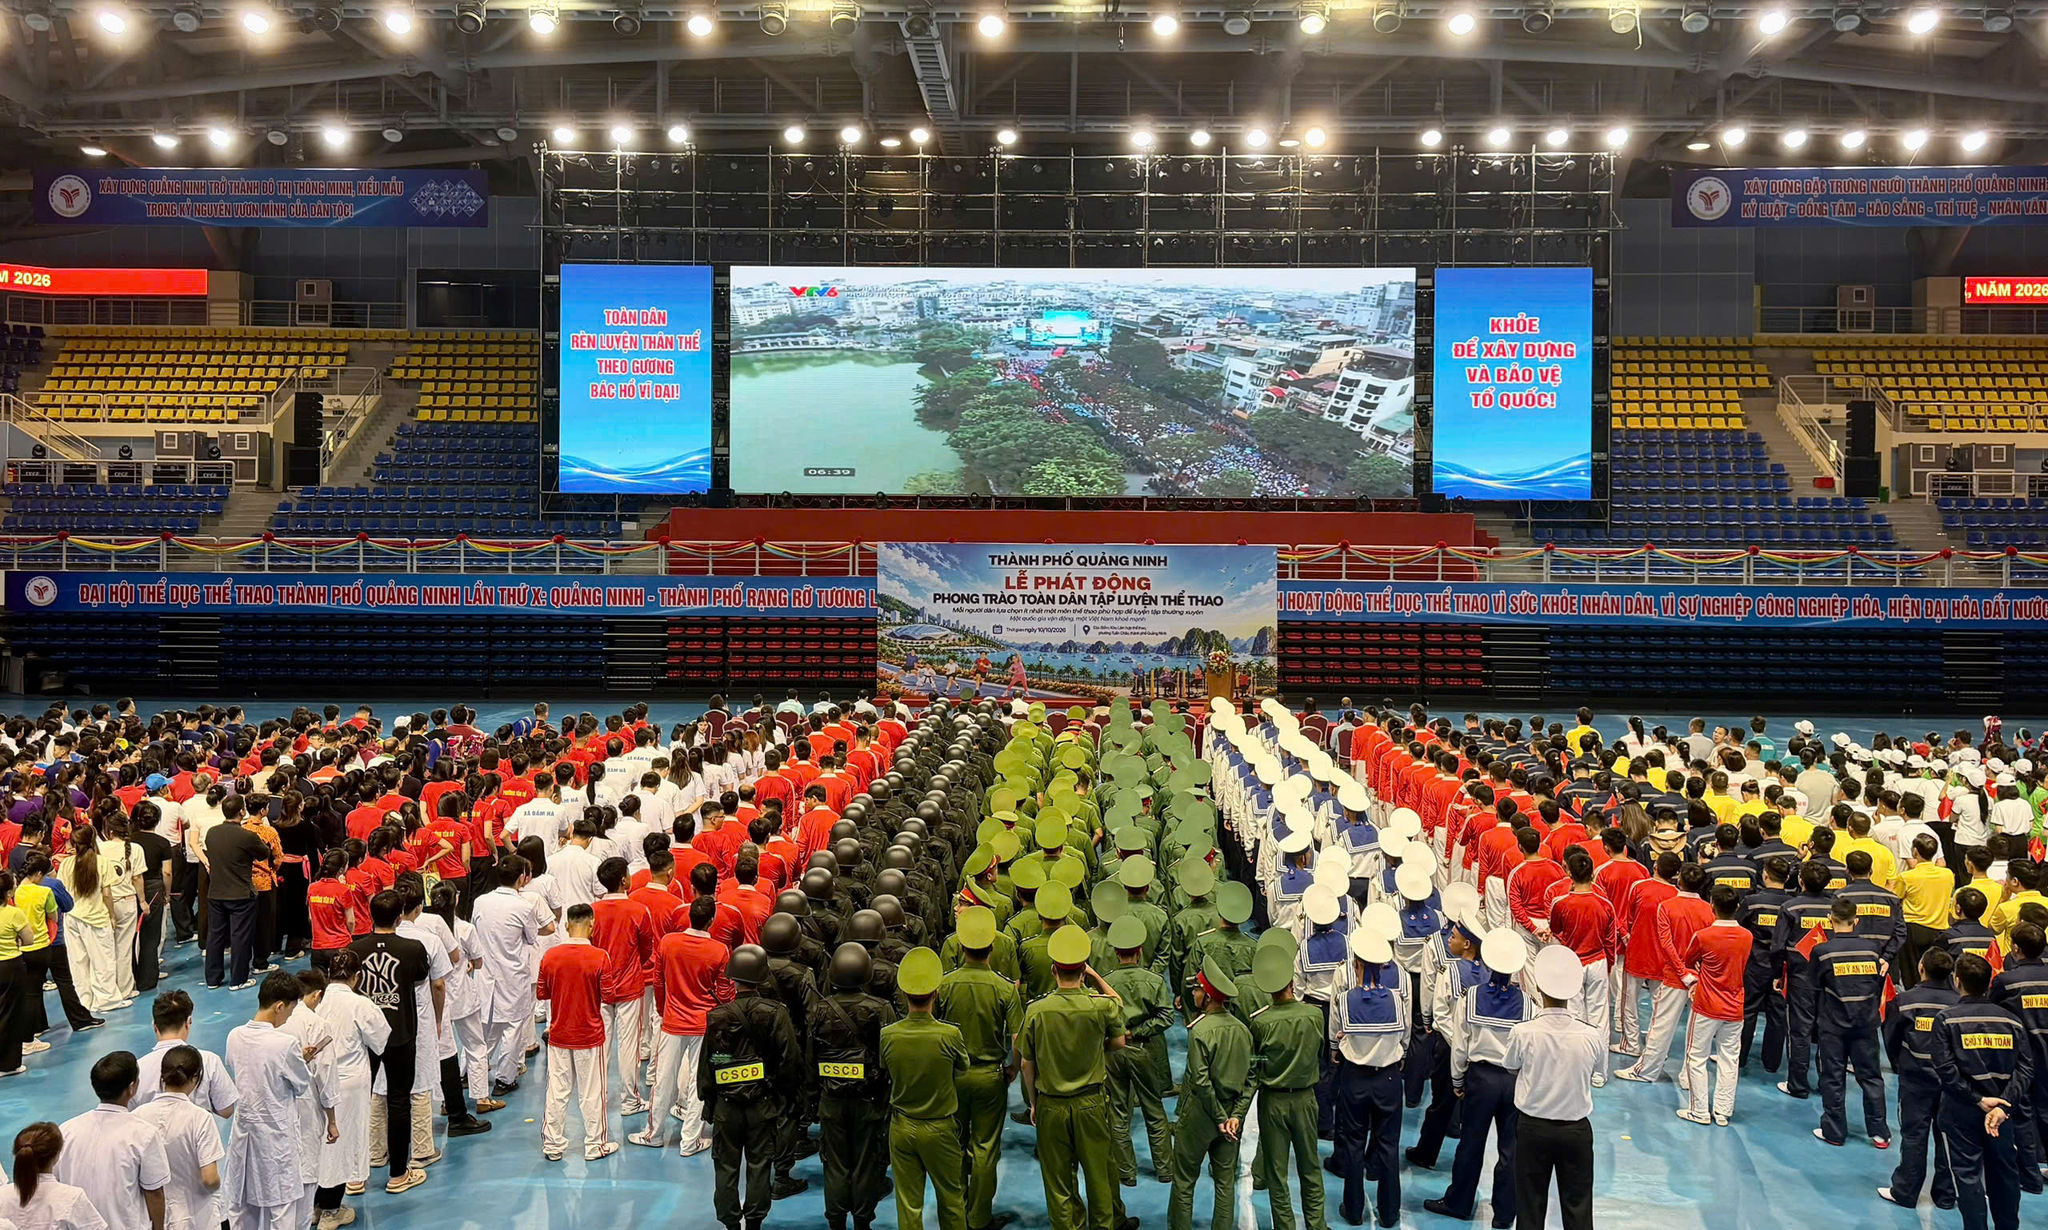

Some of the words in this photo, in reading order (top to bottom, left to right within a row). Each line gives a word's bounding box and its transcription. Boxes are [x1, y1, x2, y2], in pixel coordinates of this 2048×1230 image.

[99, 177, 119, 195] XÂY
[120, 179, 147, 198] DỰNG
[149, 176, 182, 196] QUẢNG
[183, 180, 207, 195] NINH
[209, 176, 227, 195] TRỞ
[229, 177, 259, 195] THÀNH
[261, 178, 275, 195] ĐÔ
[277, 180, 292, 198] THỊ
[294, 178, 325, 195] THÔNG
[327, 180, 356, 197] MINH,
[357, 176, 379, 195] KIỂU
[381, 176, 404, 195] MẪU
[1744, 177, 1768, 195] XÂY
[1769, 179, 1802, 198] DỰNG
[1804, 176, 1826, 198] ĐẶC
[1829, 178, 1866, 195] TRƯNG
[1869, 175, 1905, 193] NGƯỜI
[1908, 175, 1946, 193] THÀNH
[1949, 173, 1973, 193] PHỐ
[1975, 173, 2015, 194] QUẢNG
[146, 202, 177, 217] TRONG
[179, 198, 192, 217] KỶ
[194, 199, 232, 217] NGUYÊN
[234, 201, 259, 218] VƯƠN
[261, 200, 288, 218] MÌNH
[289, 199, 308, 218] CỦA
[310, 200, 330, 218] DÂN
[332, 200, 354, 221] TỘC!
[1741, 198, 1756, 218] KỶ
[1759, 200, 1788, 220] LUẬT
[1798, 198, 1829, 217] ĐỒNG
[1831, 200, 1856, 217] TÂM
[1866, 199, 1890, 216] HÀO
[1892, 197, 1925, 216] SẢNG
[1935, 198, 1953, 216] TRÍ
[1956, 199, 1977, 219] TUỆ
[1988, 198, 2021, 216] NHÂN
[14, 271, 51, 287] 2026
[1976, 281, 2011, 297] NĂM
[2015, 283, 2048, 297] 2026
[789, 286, 838, 298] VTV6
[604, 306, 638, 326] TOÀN
[641, 307, 667, 326] DÂN
[1490, 312, 1539, 334] KHỎE
[570, 330, 597, 350] RÈN
[599, 331, 638, 353] LUYỆN
[641, 331, 674, 350] THÂN
[677, 329, 701, 351] THỂ
[1453, 336, 1479, 358] ĐỂ
[1482, 339, 1519, 358] XÂY
[1523, 340, 1576, 362] DỰNG
[597, 359, 628, 374] THEO
[631, 359, 674, 375] GƯƠNG
[1465, 363, 1491, 383] VÀ
[1495, 362, 1533, 383] BẢO
[1539, 364, 1562, 386] VỆ
[590, 380, 616, 399] BÁC
[618, 378, 636, 399] HỒ
[638, 381, 652, 399] VĨ
[654, 383, 680, 403] ĐẠI!
[1470, 386, 1495, 408] TỔ
[1498, 386, 1556, 409] QUỐC!
[988, 552, 1038, 566] THÀNH
[1042, 550, 1074, 566] PHỐ
[1076, 552, 1129, 567] QUẢNG
[1133, 555, 1168, 567] NINH
[1005, 570, 1028, 590] LỄ
[1034, 572, 1087, 591] PHÁT
[1092, 573, 1151, 594] ĐỘNG
[79, 582, 105, 607] ĐẠI
[109, 580, 134, 608] HỘI
[138, 577, 167, 604] THỂ
[170, 583, 200, 608] DỤC
[204, 577, 233, 604] THỂ
[235, 585, 273, 605] THAO
[277, 582, 326, 605] THÀNH
[331, 579, 364, 605] PHỐ
[366, 580, 418, 607] QUẢNG
[422, 586, 460, 606] NINH
[464, 580, 494, 606] LẦN
[499, 583, 529, 606] THỨ
[530, 587, 547, 607] X:
[550, 581, 603, 608] QUẢNG
[606, 587, 645, 607] NINH
[658, 584, 708, 607] THÀNH
[712, 582, 744, 608] PHỐ
[747, 588, 789, 611] RẠNG
[792, 585, 813, 608] RỠ
[816, 587, 865, 608] TƯƠNG
[933, 593, 980, 605] PHONG
[982, 591, 1017, 605] TRÀO
[1019, 591, 1056, 605] TOÀN
[1059, 592, 1087, 605] DÂN
[1090, 592, 1115, 608] TẬP
[1117, 592, 1158, 608] LUYỆN
[1161, 590, 1185, 606] THỂ
[1188, 595, 1224, 607] THAO
[1287, 591, 1322, 616] HOẠT
[1324, 588, 1363, 617] ĐỘNG
[1366, 585, 1392, 612] THỂ
[1394, 593, 1422, 617] DỤC
[1425, 586, 1452, 613] THỂ
[1454, 593, 1489, 614] THAO
[1492, 590, 1506, 614] VÌ
[1509, 590, 1538, 614] SỨC
[1541, 588, 1578, 615] KHỎE
[1581, 591, 1621, 616] NHÂN
[1624, 592, 1658, 617] DÂN,
[1661, 592, 1675, 616] VÌ
[1678, 594, 1700, 621] SỰ
[1701, 592, 1753, 621] NGHIỆP
[1756, 593, 1794, 617] CÔNG
[1797, 594, 1849, 621] NGHIỆP
[1853, 594, 1885, 621] HÓA,
[1888, 594, 1923, 623] HIỆN
[1925, 598, 1948, 623] ĐẠI
[1951, 595, 1980, 619] HÓA
[1983, 593, 2010, 620] ĐẤT
[2013, 596, 2048, 620] NƯỚC
[1983, 1038, 1992, 1046] AN
[720, 1069, 759, 1081] CSCĐ
[823, 1064, 859, 1076] CSCĐ
